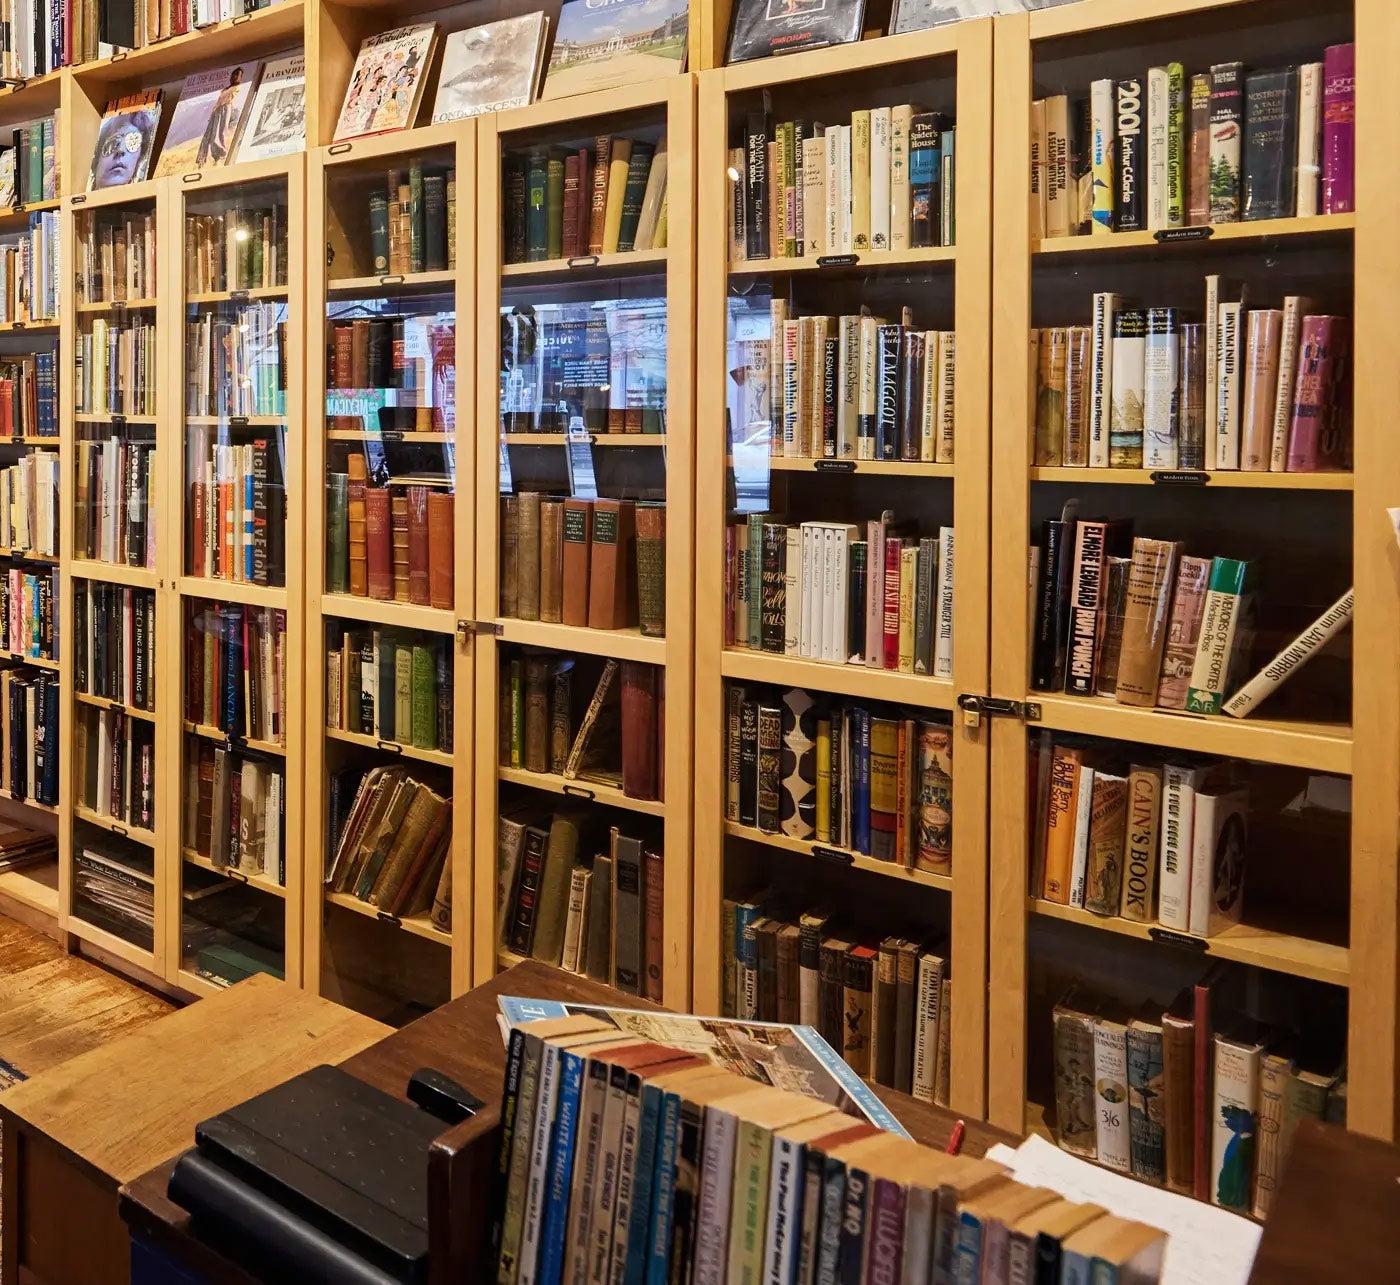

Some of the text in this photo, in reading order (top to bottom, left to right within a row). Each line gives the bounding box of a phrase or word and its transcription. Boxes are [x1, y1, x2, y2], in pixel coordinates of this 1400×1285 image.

[1168, 74, 1180, 87] The
[1118, 82, 1141, 136] 2001
[914, 123, 932, 132] The
[756, 134, 766, 184] SYMPATHY
[912, 138, 936, 150] House
[1122, 136, 1134, 167] Arthur
[594, 169, 605, 188] AND
[1168, 160, 1180, 198] Carrington
[592, 190, 605, 212] LOSE
[1096, 296, 1105, 324] CHITTY
[846, 320, 858, 340] April
[1096, 323, 1105, 350] CHITTY
[1225, 312, 1235, 374] DISTINGUISHED
[824, 342, 834, 402] SHUSAKU ENDO
[1096, 351, 1105, 372] BANG
[846, 371, 858, 404] Odyssey
[882, 363, 897, 428] MAGGOT
[1096, 373, 1105, 394] BANG
[1096, 409, 1105, 442] Fleming
[944, 535, 954, 556] ANNA
[736, 550, 744, 600] ANGELA HUTH
[944, 558, 954, 582] KAVAN
[942, 591, 952, 622] STRANGER
[1072, 526, 1102, 677] ELMORE LEONARD RUM PUNCH
[940, 624, 951, 639] STILL
[1206, 596, 1234, 690] MEMOIRS OF THE FORTIES
[1265, 627, 1326, 681] JAN MORRIS
[760, 718, 780, 731] DEAD
[760, 730, 779, 738] MEN
[730, 752, 740, 784] MORRIS
[1048, 788, 1061, 828] Southern
[1060, 790, 1074, 813] Terry
[1127, 778, 1154, 910] CAIN'S BOOK
[927, 971, 938, 1022] TOM WOLFE
[558, 1101, 572, 1147] WHITE
[771, 1161, 790, 1276] The Paul McCartney
